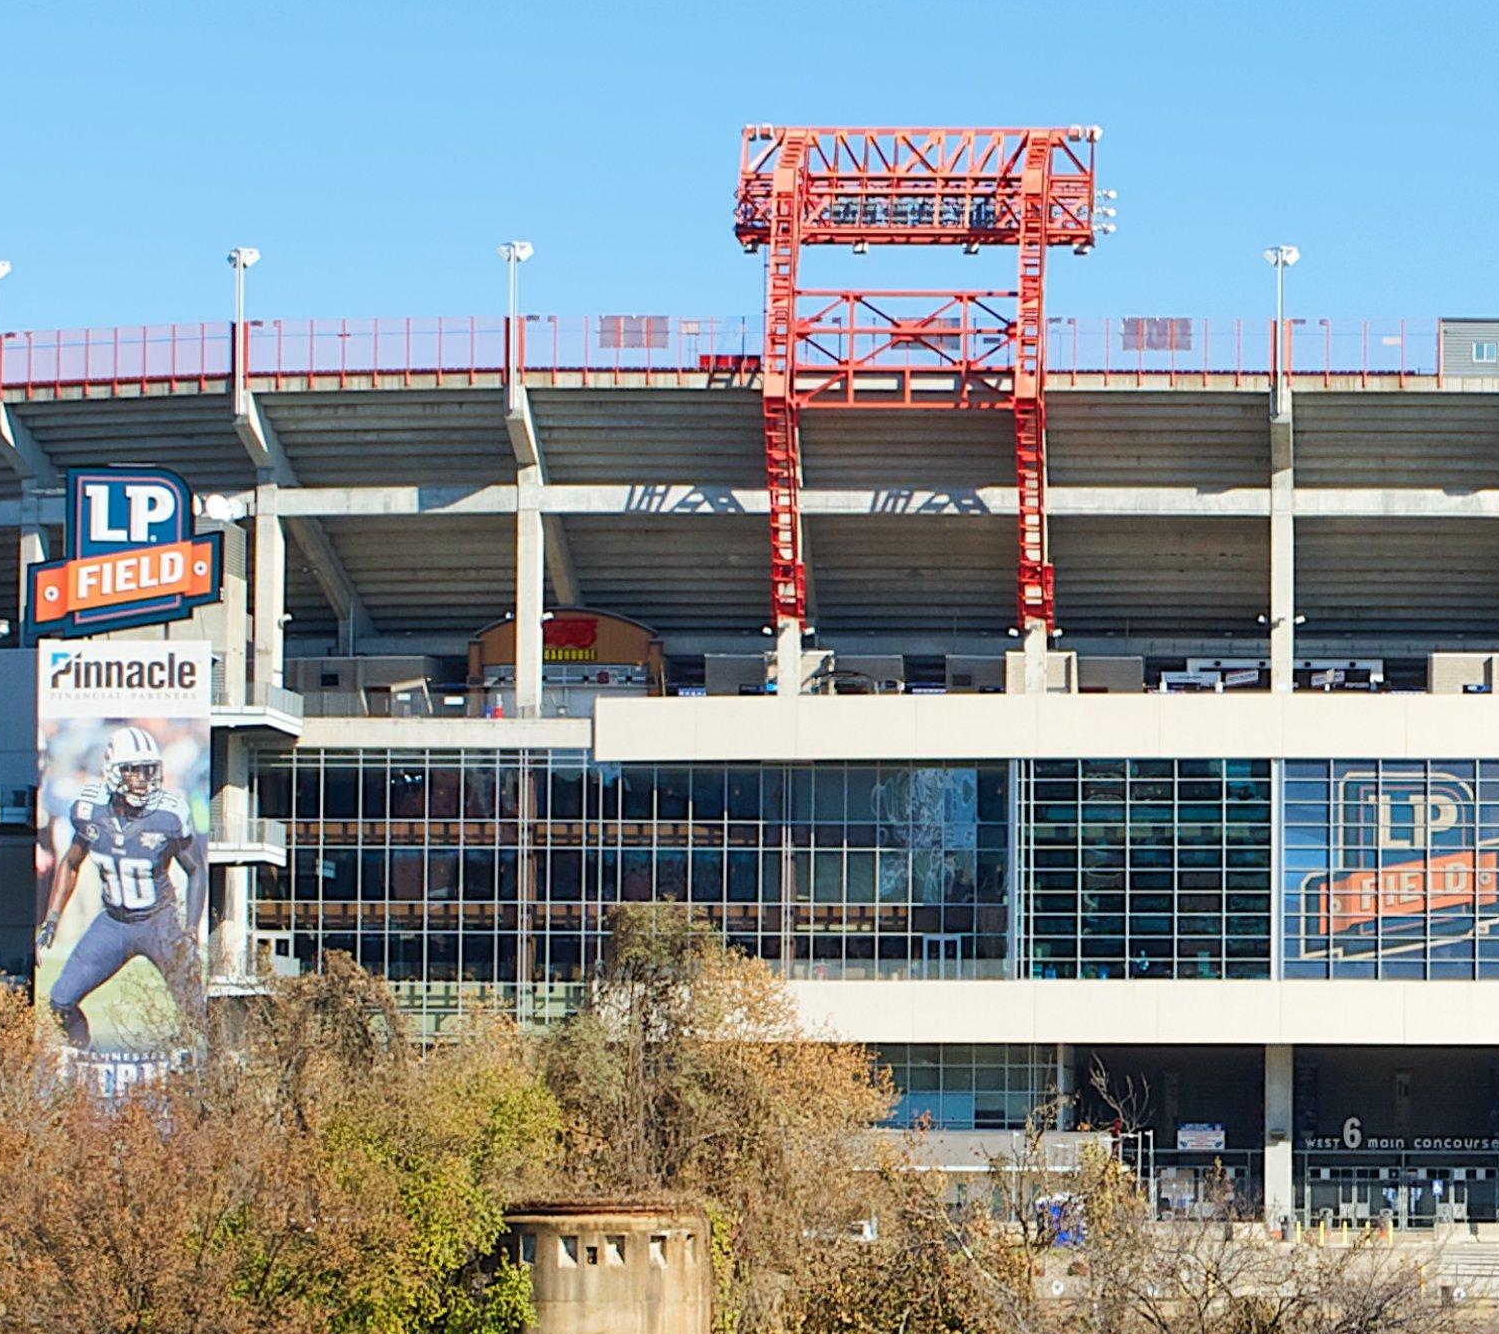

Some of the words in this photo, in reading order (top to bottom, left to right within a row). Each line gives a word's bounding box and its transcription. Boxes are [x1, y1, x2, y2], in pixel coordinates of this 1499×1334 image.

[84, 484, 176, 543] LP
[76, 551, 185, 599] FIELD
[51, 650, 197, 689] Pinnacle
[1367, 794, 1458, 849] LP
[1360, 861, 1468, 911] FIELD
[1343, 1117, 1362, 1149] 6
[1367, 1137, 1405, 1149] main
